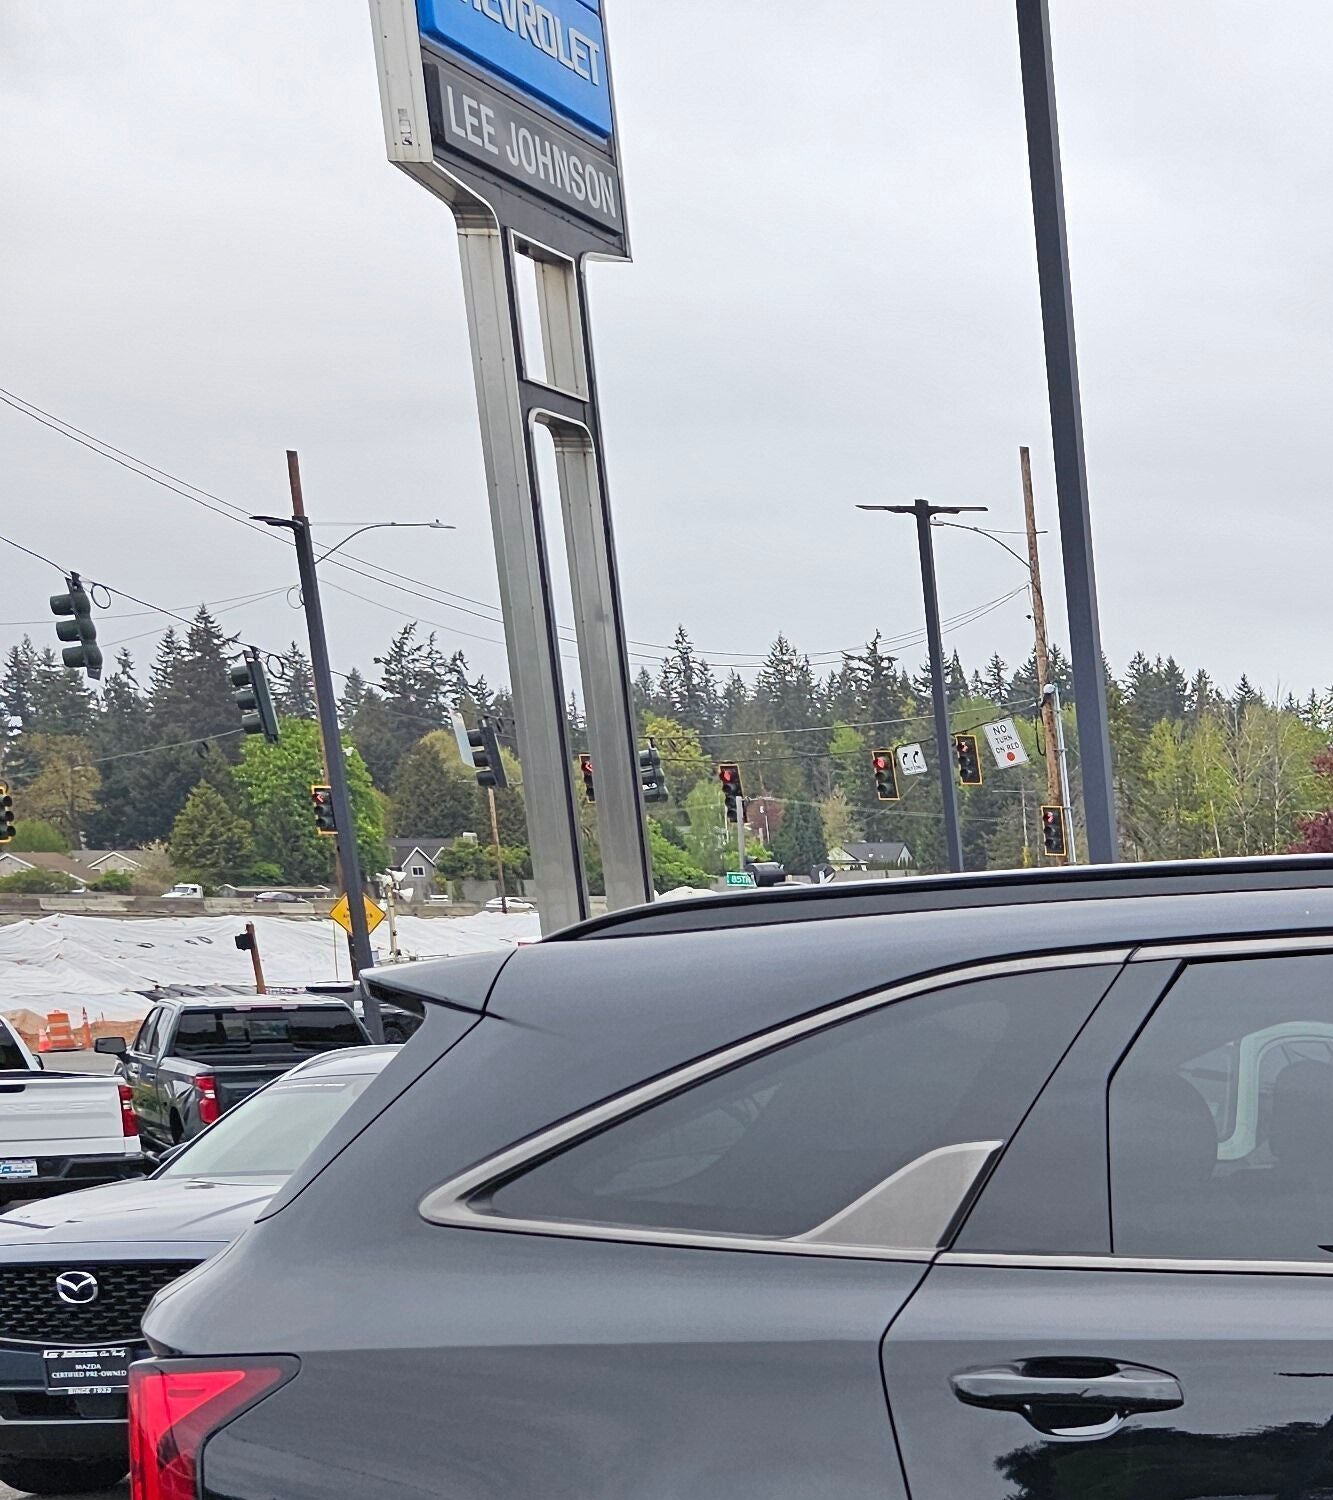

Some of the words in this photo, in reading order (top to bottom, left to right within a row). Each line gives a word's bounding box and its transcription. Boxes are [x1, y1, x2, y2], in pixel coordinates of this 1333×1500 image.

[461, 0, 600, 86] VROLET
[447, 85, 499, 155] LEE
[506, 121, 617, 218] JOHNSON
[993, 724, 1007, 735] NO
[995, 735, 1013, 744] TURN
[1006, 741, 1020, 750] RED
[51, 1371, 85, 1379] CERTIFIED
[86, 1370, 127, 1378] PRE-OWNED
